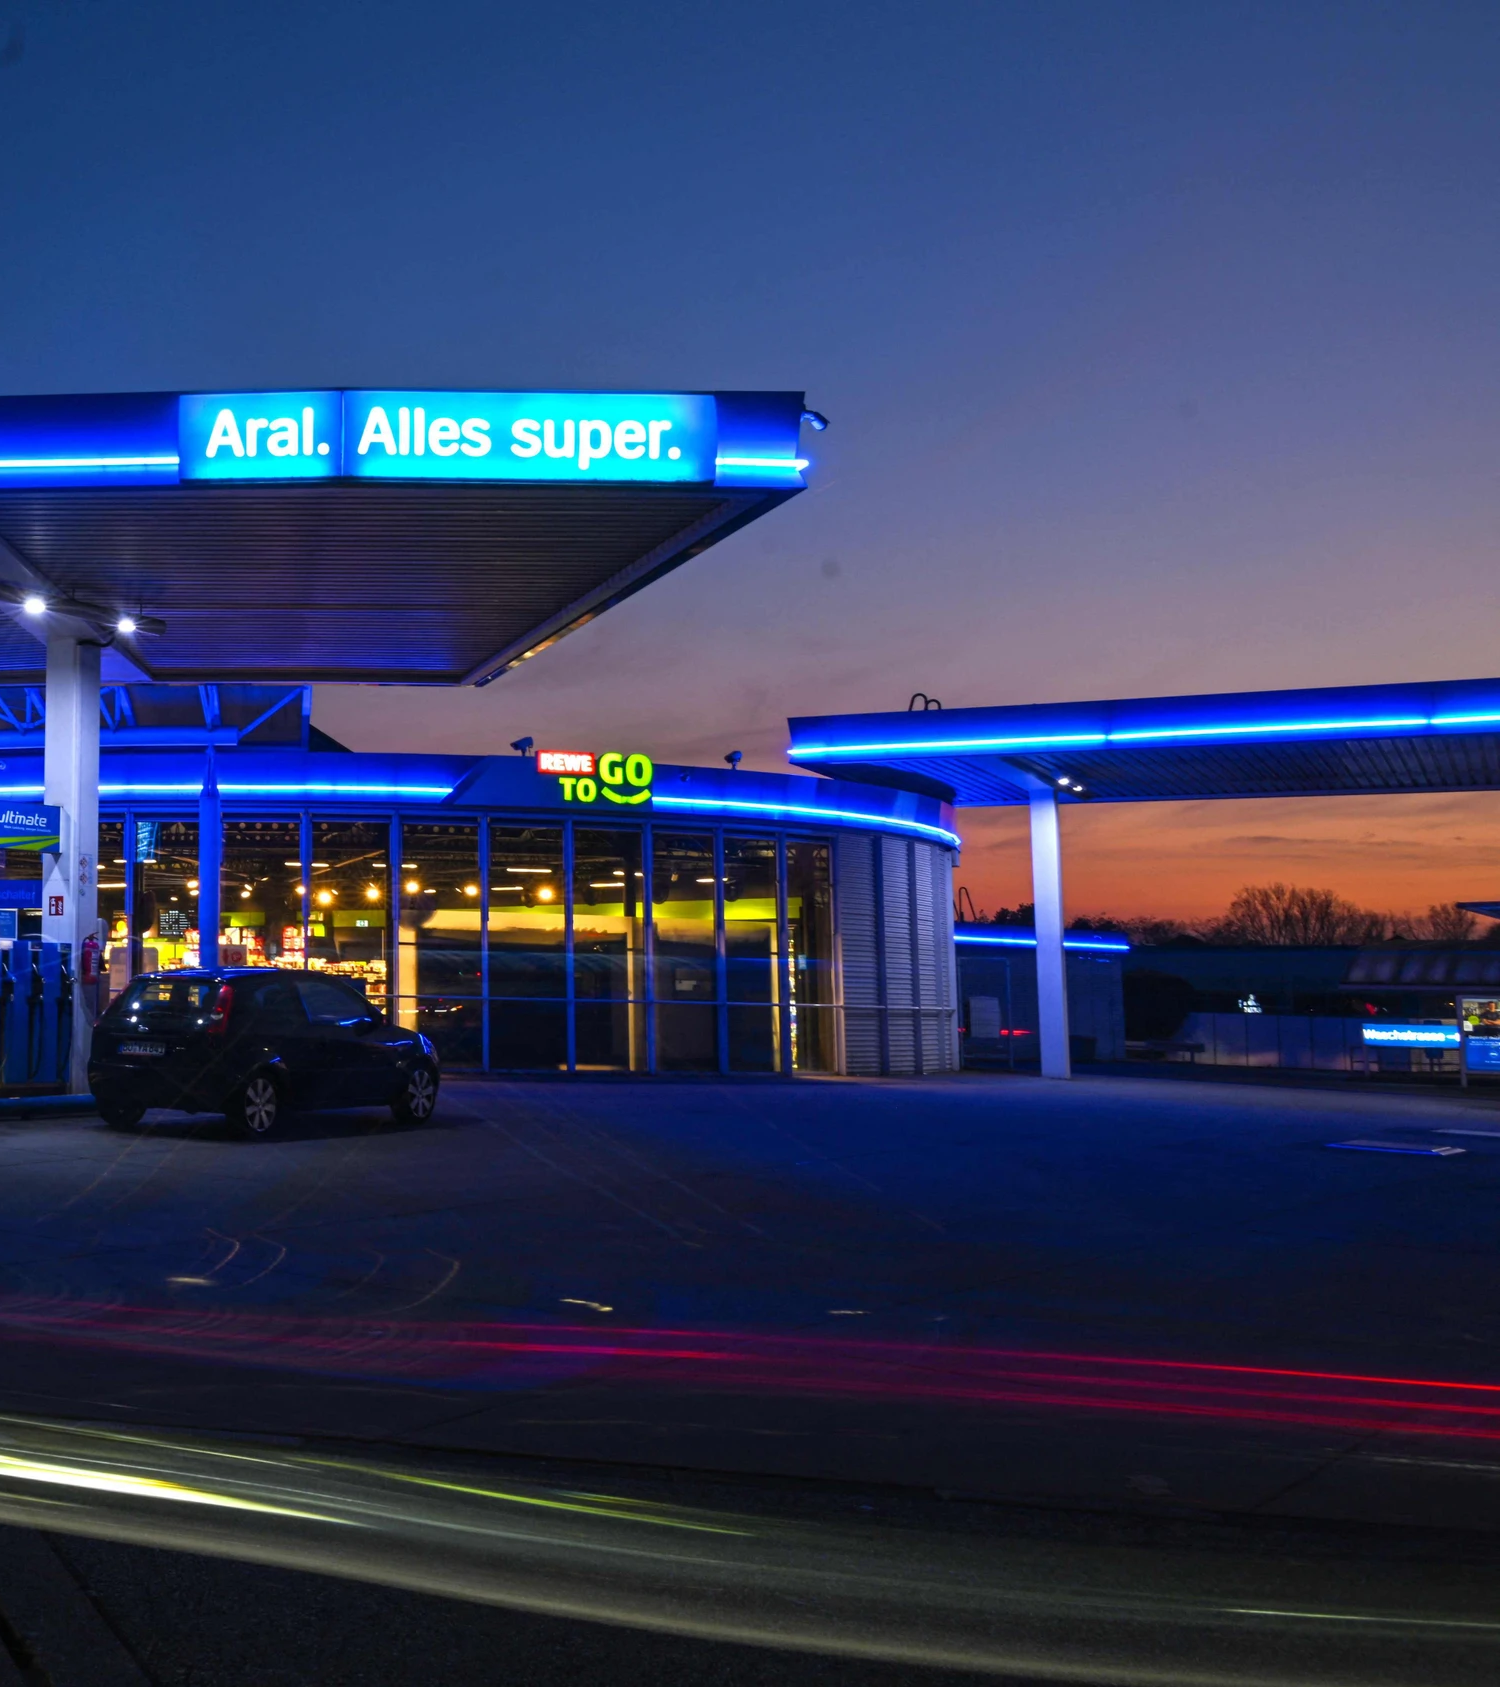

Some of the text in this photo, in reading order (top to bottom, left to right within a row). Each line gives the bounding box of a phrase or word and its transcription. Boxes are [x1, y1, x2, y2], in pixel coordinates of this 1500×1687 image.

[205, 407, 330, 458] Aral.
[357, 406, 682, 471] Alles super.
[540, 752, 653, 787] REWE GO
[558, 777, 598, 803] TO
